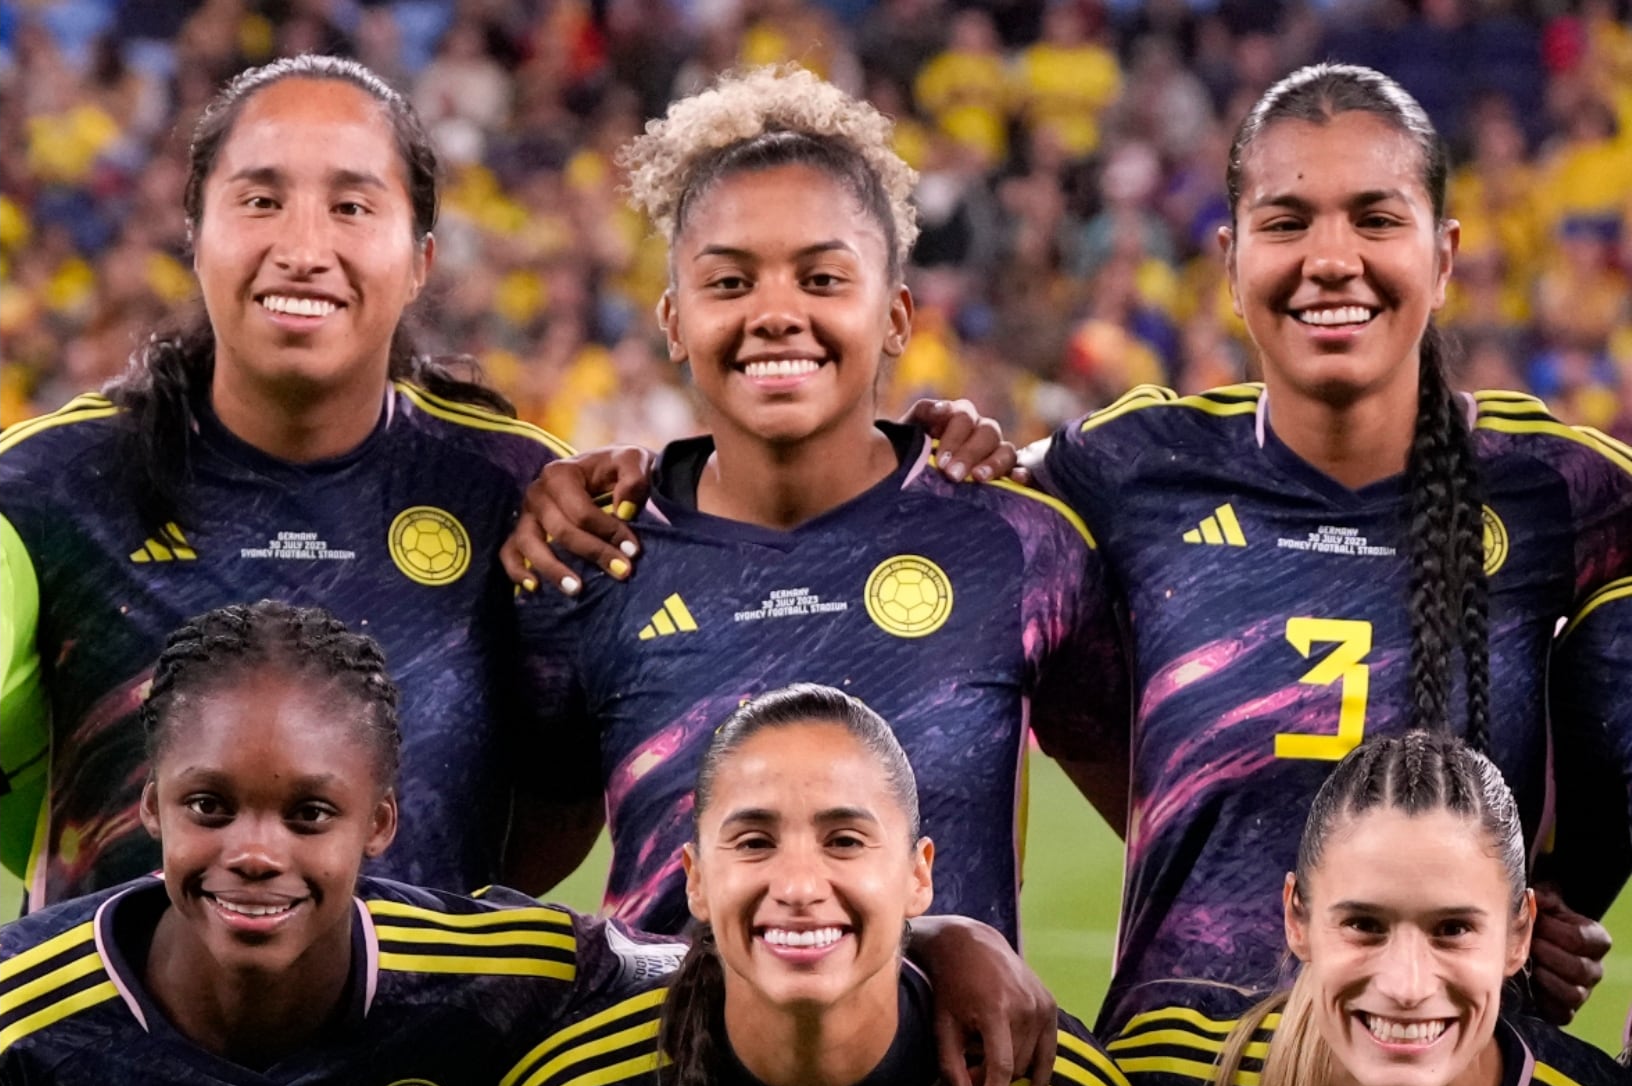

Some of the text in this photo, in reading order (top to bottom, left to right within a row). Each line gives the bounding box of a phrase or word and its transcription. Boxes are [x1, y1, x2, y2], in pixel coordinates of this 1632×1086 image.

[277, 531, 317, 540] GERMANY
[1318, 525, 1359, 536] GERMANY
[269, 540, 327, 550] 30 JULY 2023
[1308, 532, 1367, 546] 30 JULY 2023
[1277, 537, 1397, 556] SYDNEY FOOTBALL STADIUM
[241, 548, 273, 558] SYDNEY
[274, 549, 316, 559] FOOTBALL
[770, 587, 809, 599] GERMANY
[761, 595, 818, 609] 30 JULY 2023
[734, 602, 848, 622] SYDNEY FOOTBALL STADIUM
[1274, 617, 1372, 762] 3
